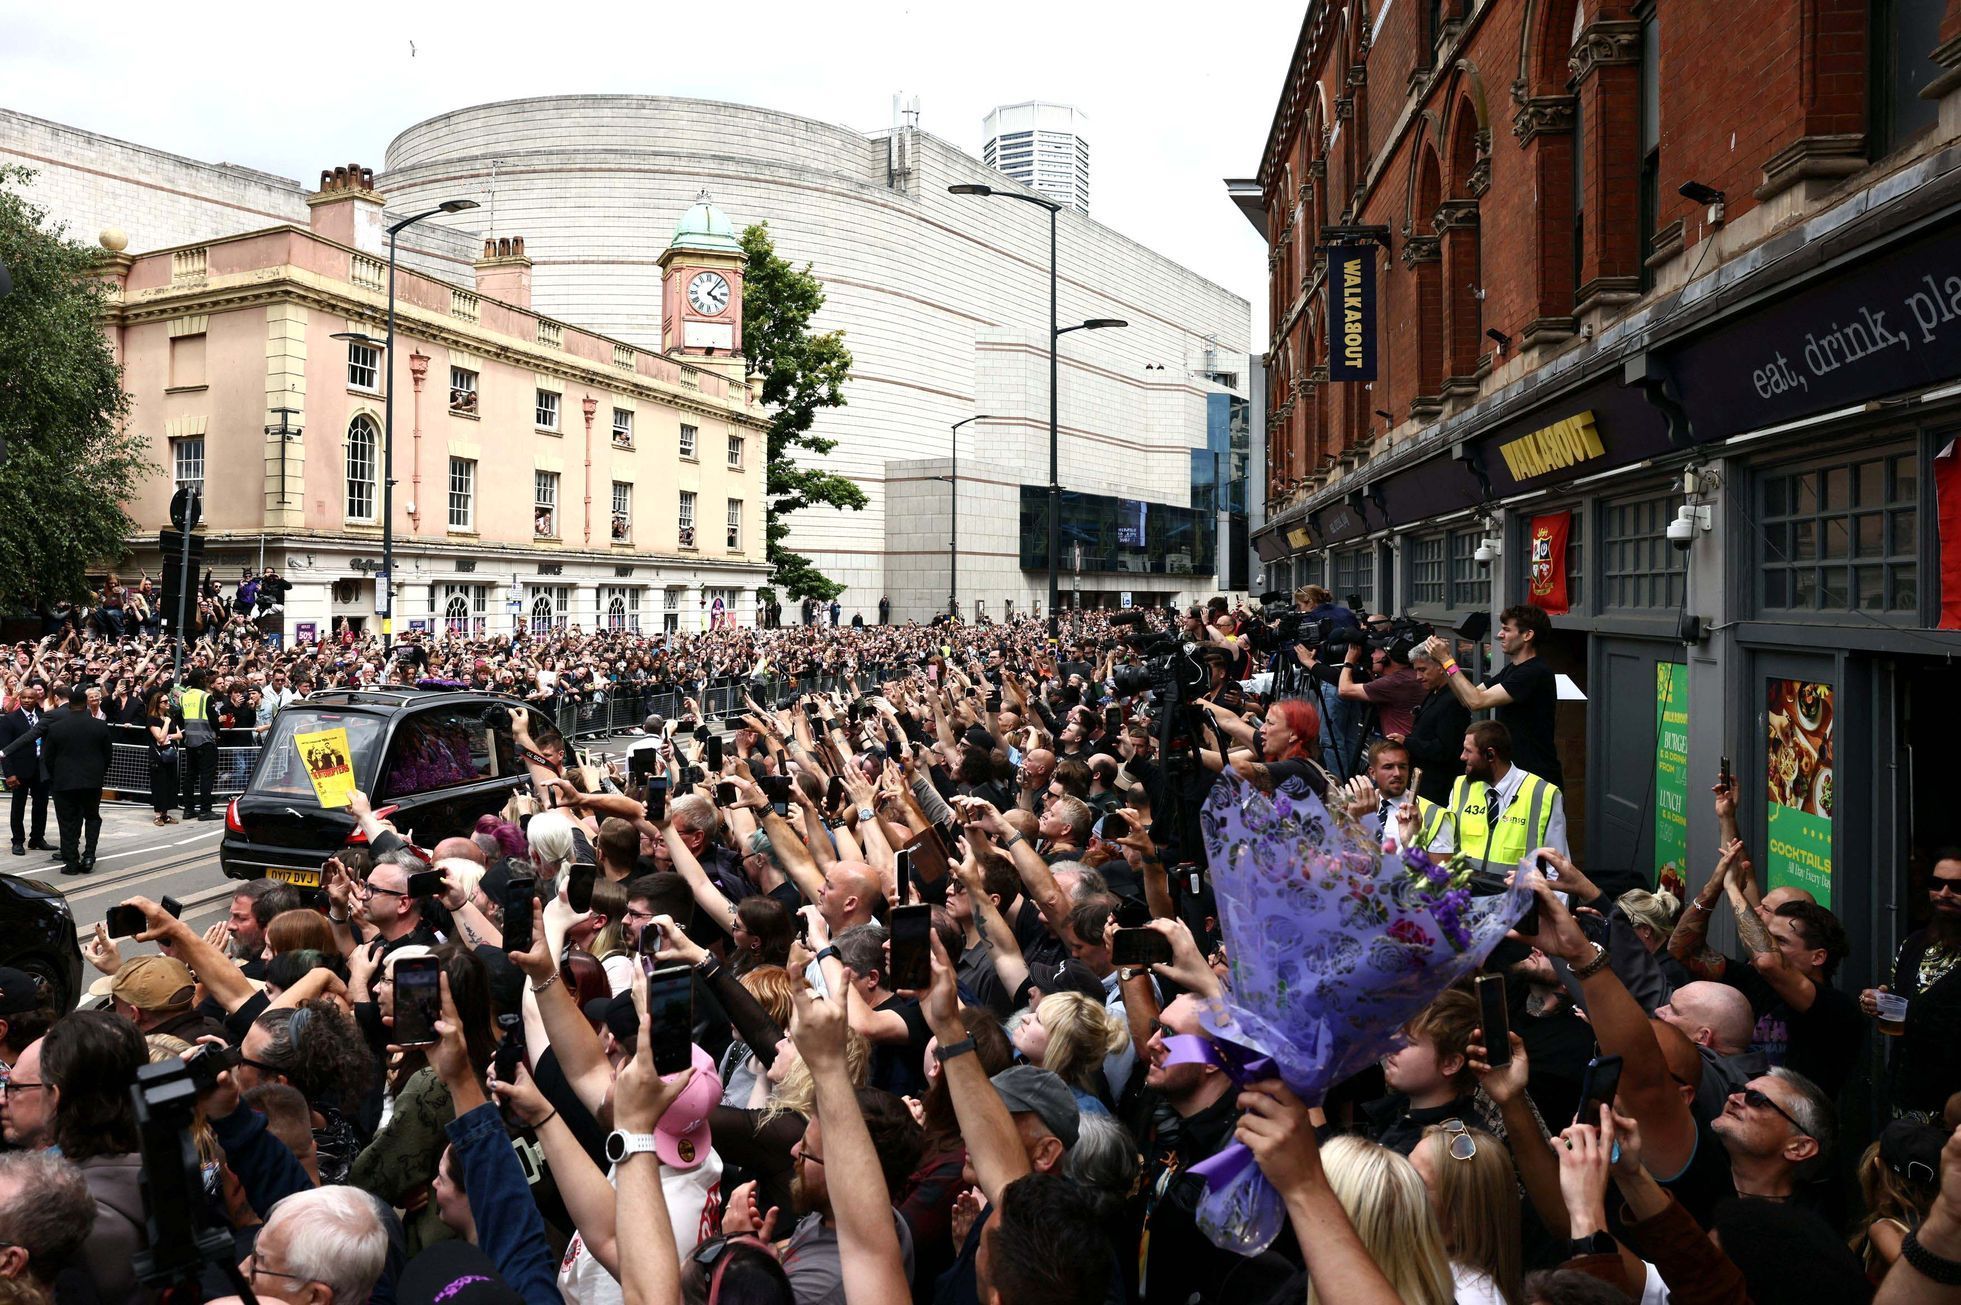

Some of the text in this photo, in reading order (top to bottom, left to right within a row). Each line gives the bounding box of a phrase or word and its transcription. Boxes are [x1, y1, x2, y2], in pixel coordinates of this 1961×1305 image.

[1343, 258, 1362, 369] WALKABOUT
[1753, 351, 1808, 399] eat,
[1804, 306, 1911, 376] drink,
[1499, 409, 1606, 482] WALKABOUT
[298, 631, 313, 640] 50%
[1659, 761, 1675, 773] FROM
[1464, 804, 1487, 815] 434
[1660, 789, 1682, 813] LUNCH
[1770, 838, 1832, 873] COCKTAILS
[294, 872, 314, 884] DVJ
[1795, 862, 1804, 880] Day
[1805, 868, 1820, 888] Every
